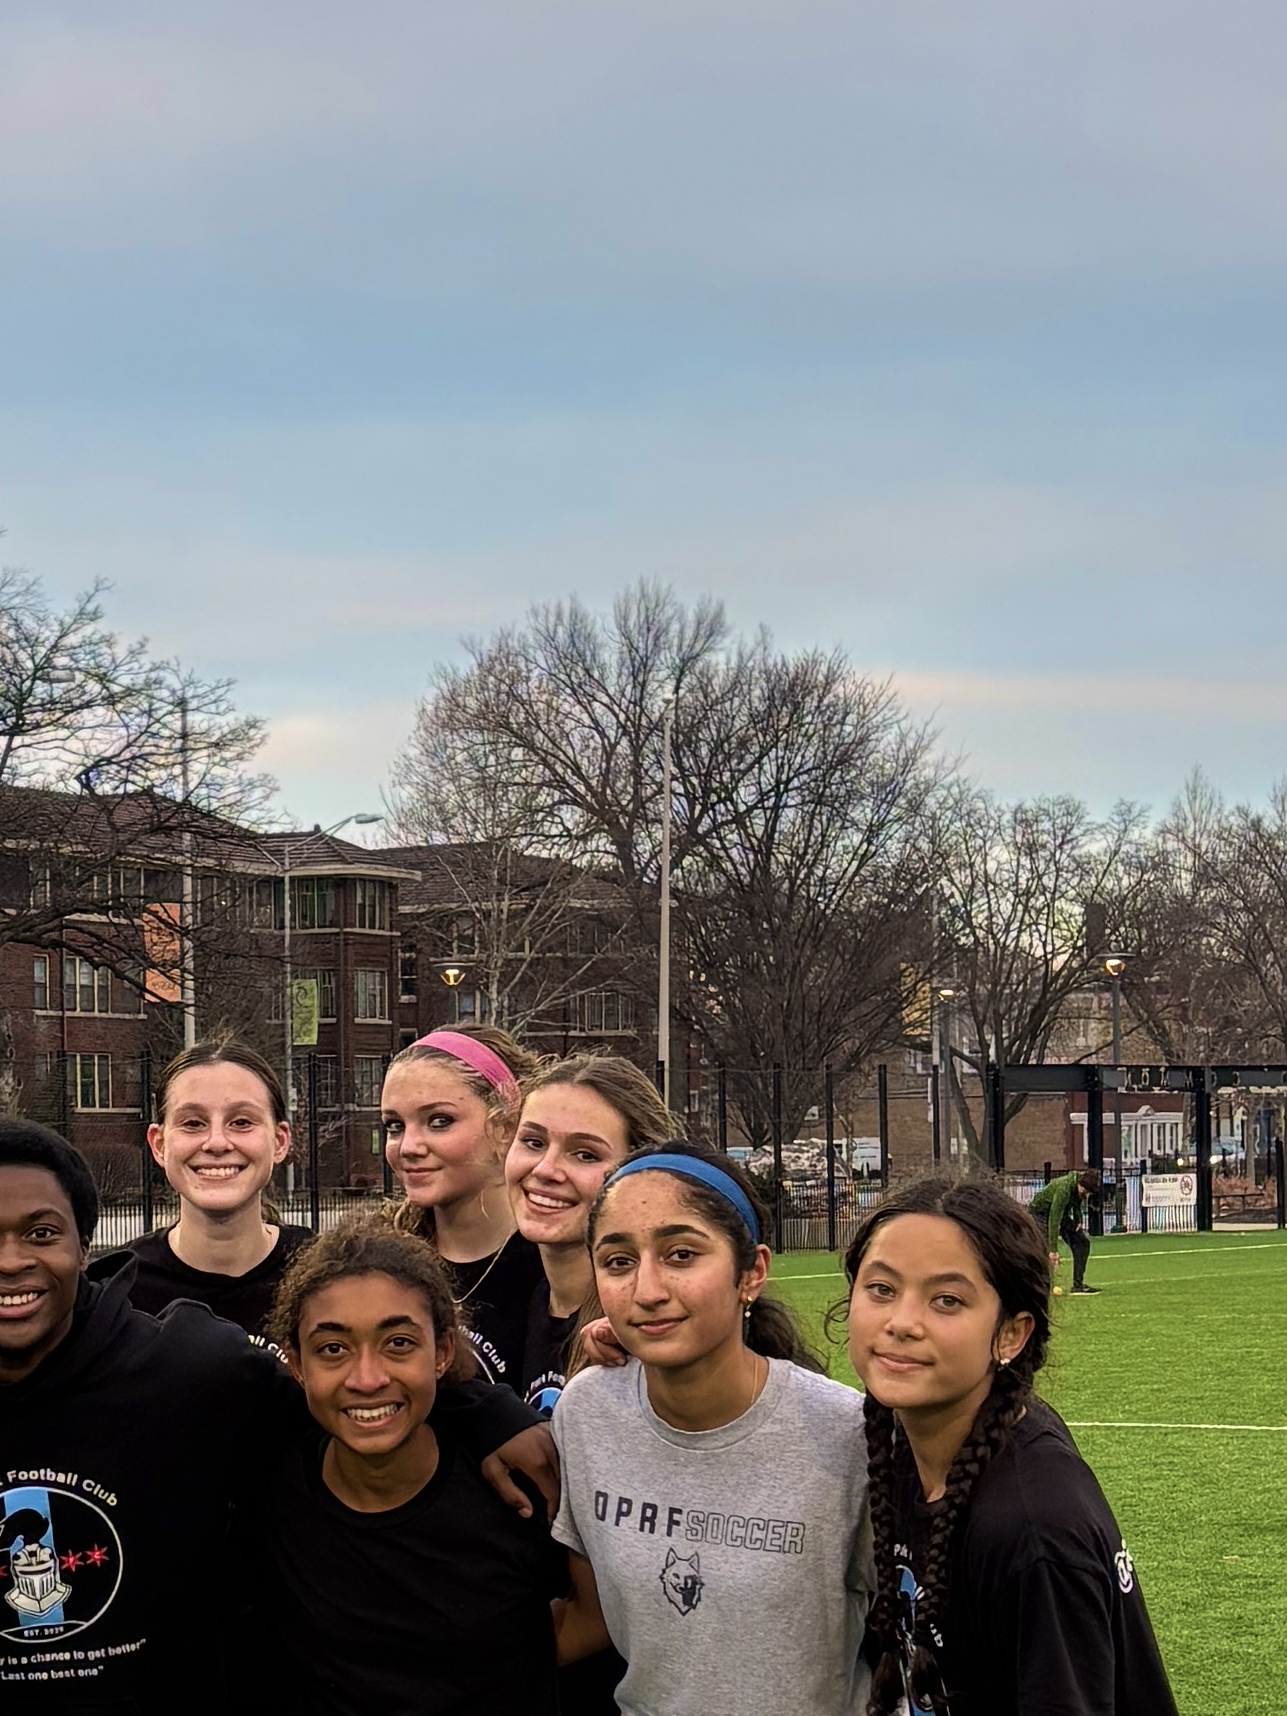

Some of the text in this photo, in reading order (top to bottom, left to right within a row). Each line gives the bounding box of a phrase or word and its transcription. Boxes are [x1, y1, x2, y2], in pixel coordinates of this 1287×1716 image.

[482, 1341, 506, 1373] Club
[7, 1468, 78, 1486] Football
[82, 1479, 118, 1506] Club
[7, 1656, 18, 1665] is
[20, 1657, 28, 1665] a
[31, 1651, 71, 1663] chance
[73, 1650, 85, 1660] to
[87, 1648, 106, 1661] get
[28, 1672, 48, 1681] one
[51, 1669, 75, 1679] best
